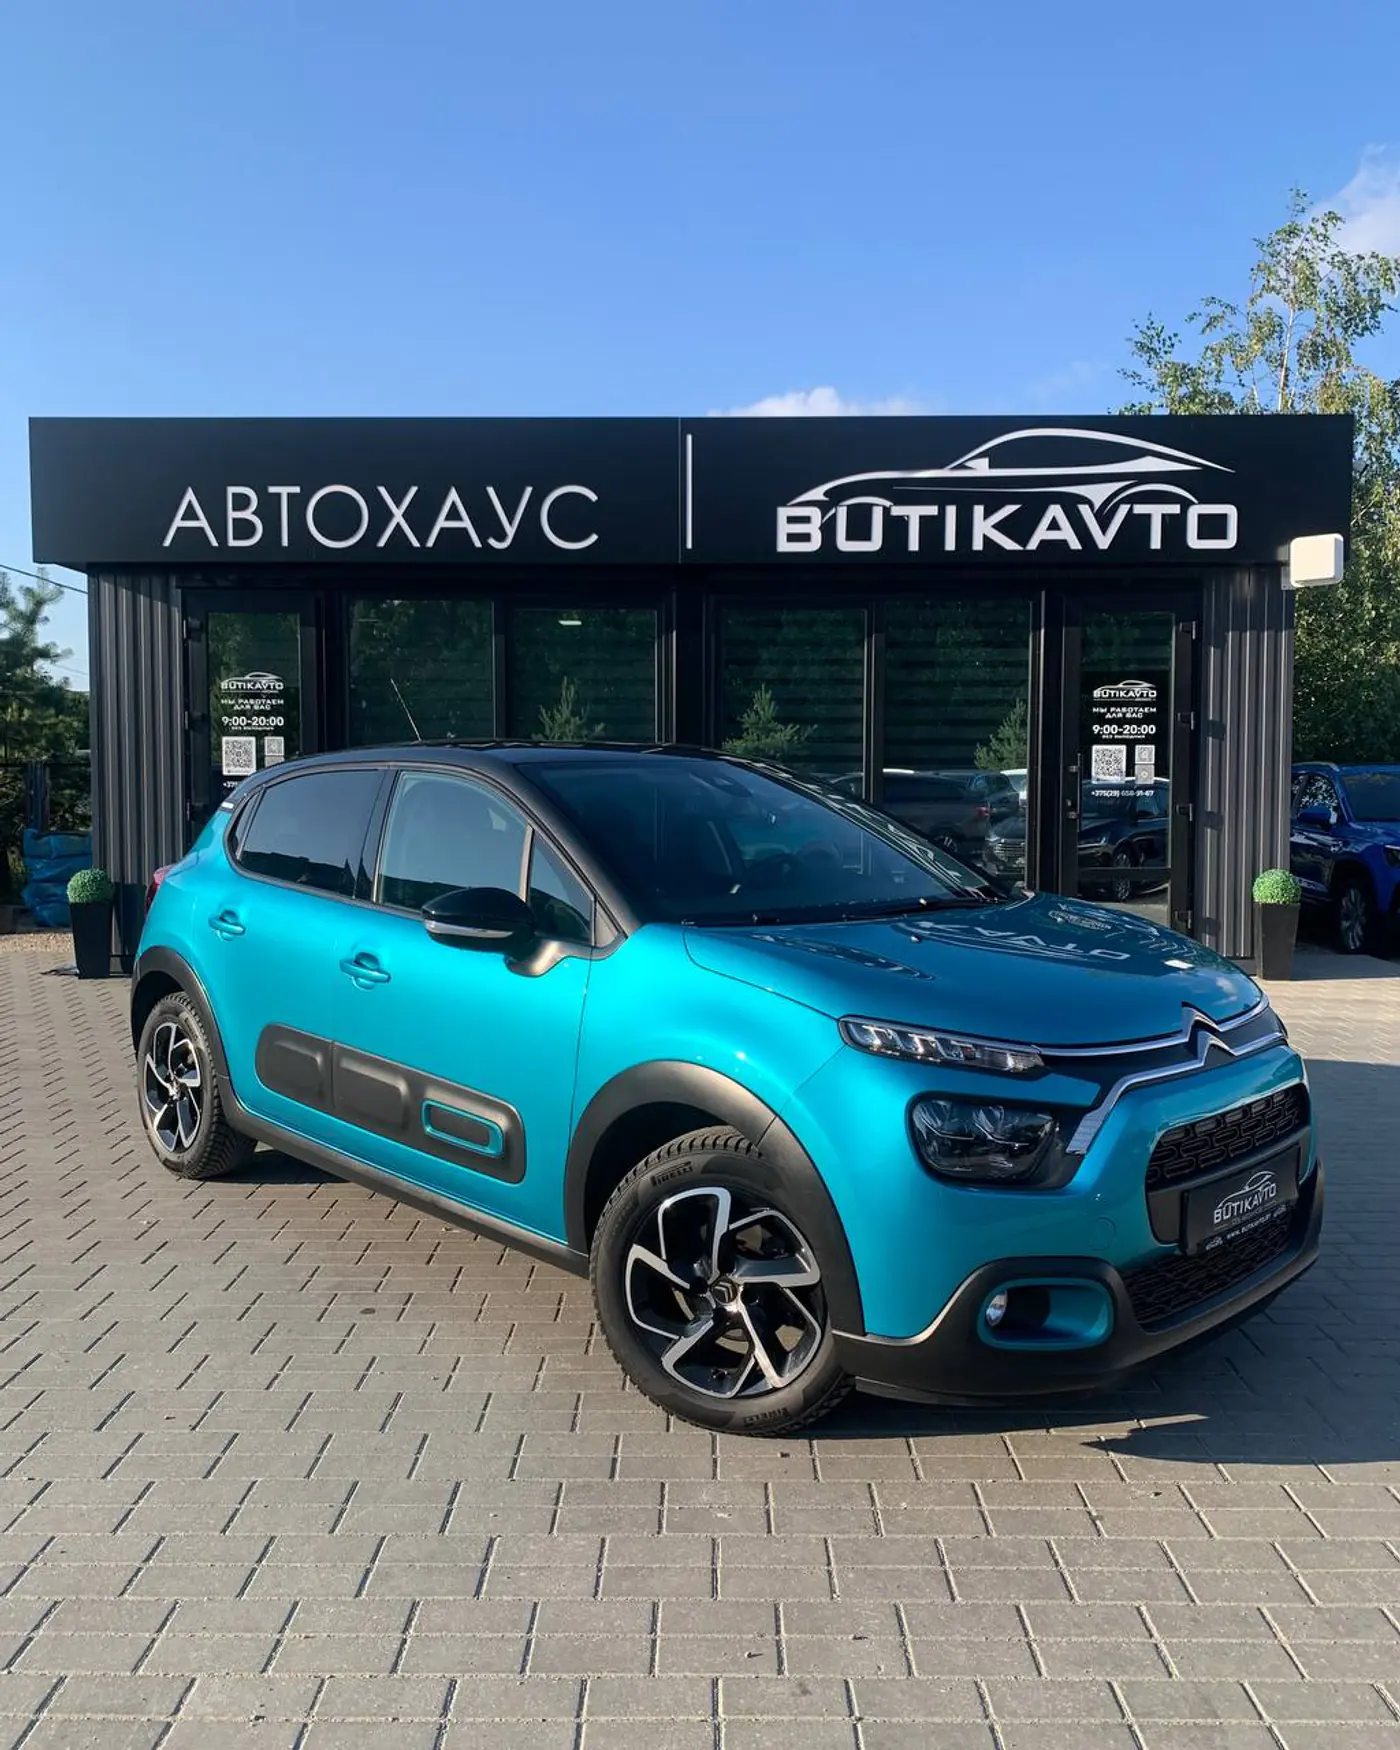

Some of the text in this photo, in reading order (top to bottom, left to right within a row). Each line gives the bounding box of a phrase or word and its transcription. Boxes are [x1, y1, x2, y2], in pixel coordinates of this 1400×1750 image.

[162, 485, 600, 551] АВТОХАУС
[775, 503, 1239, 553] BUTIKAVTO
[220, 681, 284, 690] BUTIKAVTO
[1093, 689, 1157, 698] BUTIKAVTO
[221, 716, 285, 726] 9:00-20:00
[1092, 724, 1157, 735] 9:00-20:00
[1213, 1182, 1277, 1224] BUTIKAVTO
